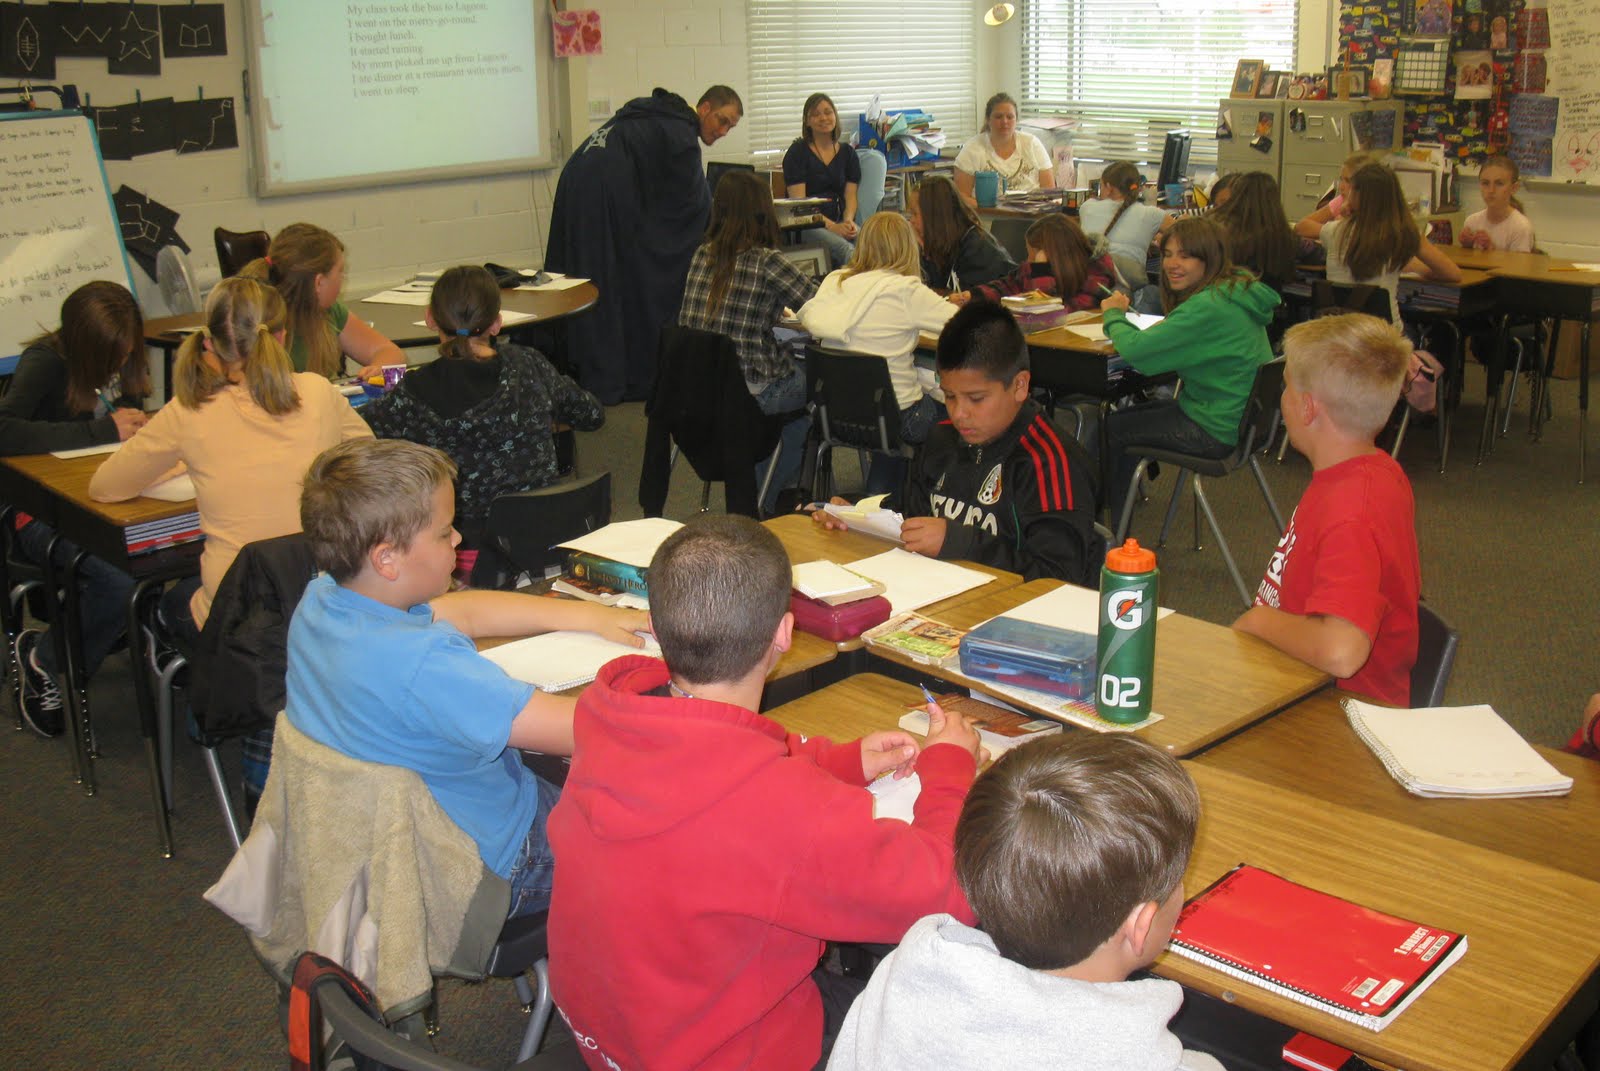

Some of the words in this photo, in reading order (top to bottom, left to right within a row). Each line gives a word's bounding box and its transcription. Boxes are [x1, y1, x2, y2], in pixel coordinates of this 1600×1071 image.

[347, 5, 363, 17] My
[366, 4, 388, 14] class
[390, 3, 409, 14] took
[412, 3, 425, 13] the
[427, 2, 442, 13] bus
[445, 3, 454, 12] to
[354, 19, 377, 29] went
[379, 20, 391, 28] on
[393, 17, 407, 27] the
[355, 31, 387, 44] bought
[359, 44, 390, 56] started
[351, 60, 367, 72] My
[369, 61, 392, 70] mom
[395, 57, 424, 69] picked
[426, 57, 439, 65] me
[441, 57, 453, 67] up
[455, 54, 475, 63] from
[359, 75, 372, 84] ate
[374, 72, 402, 83] dinner
[405, 72, 414, 80] at
[423, 68, 464, 79] restaurant
[467, 66, 486, 76] with
[487, 67, 499, 77] my
[360, 87, 381, 97] went
[384, 87, 393, 96] to
[1108, 590, 1142, 630] G
[1101, 674, 1141, 708] 02
